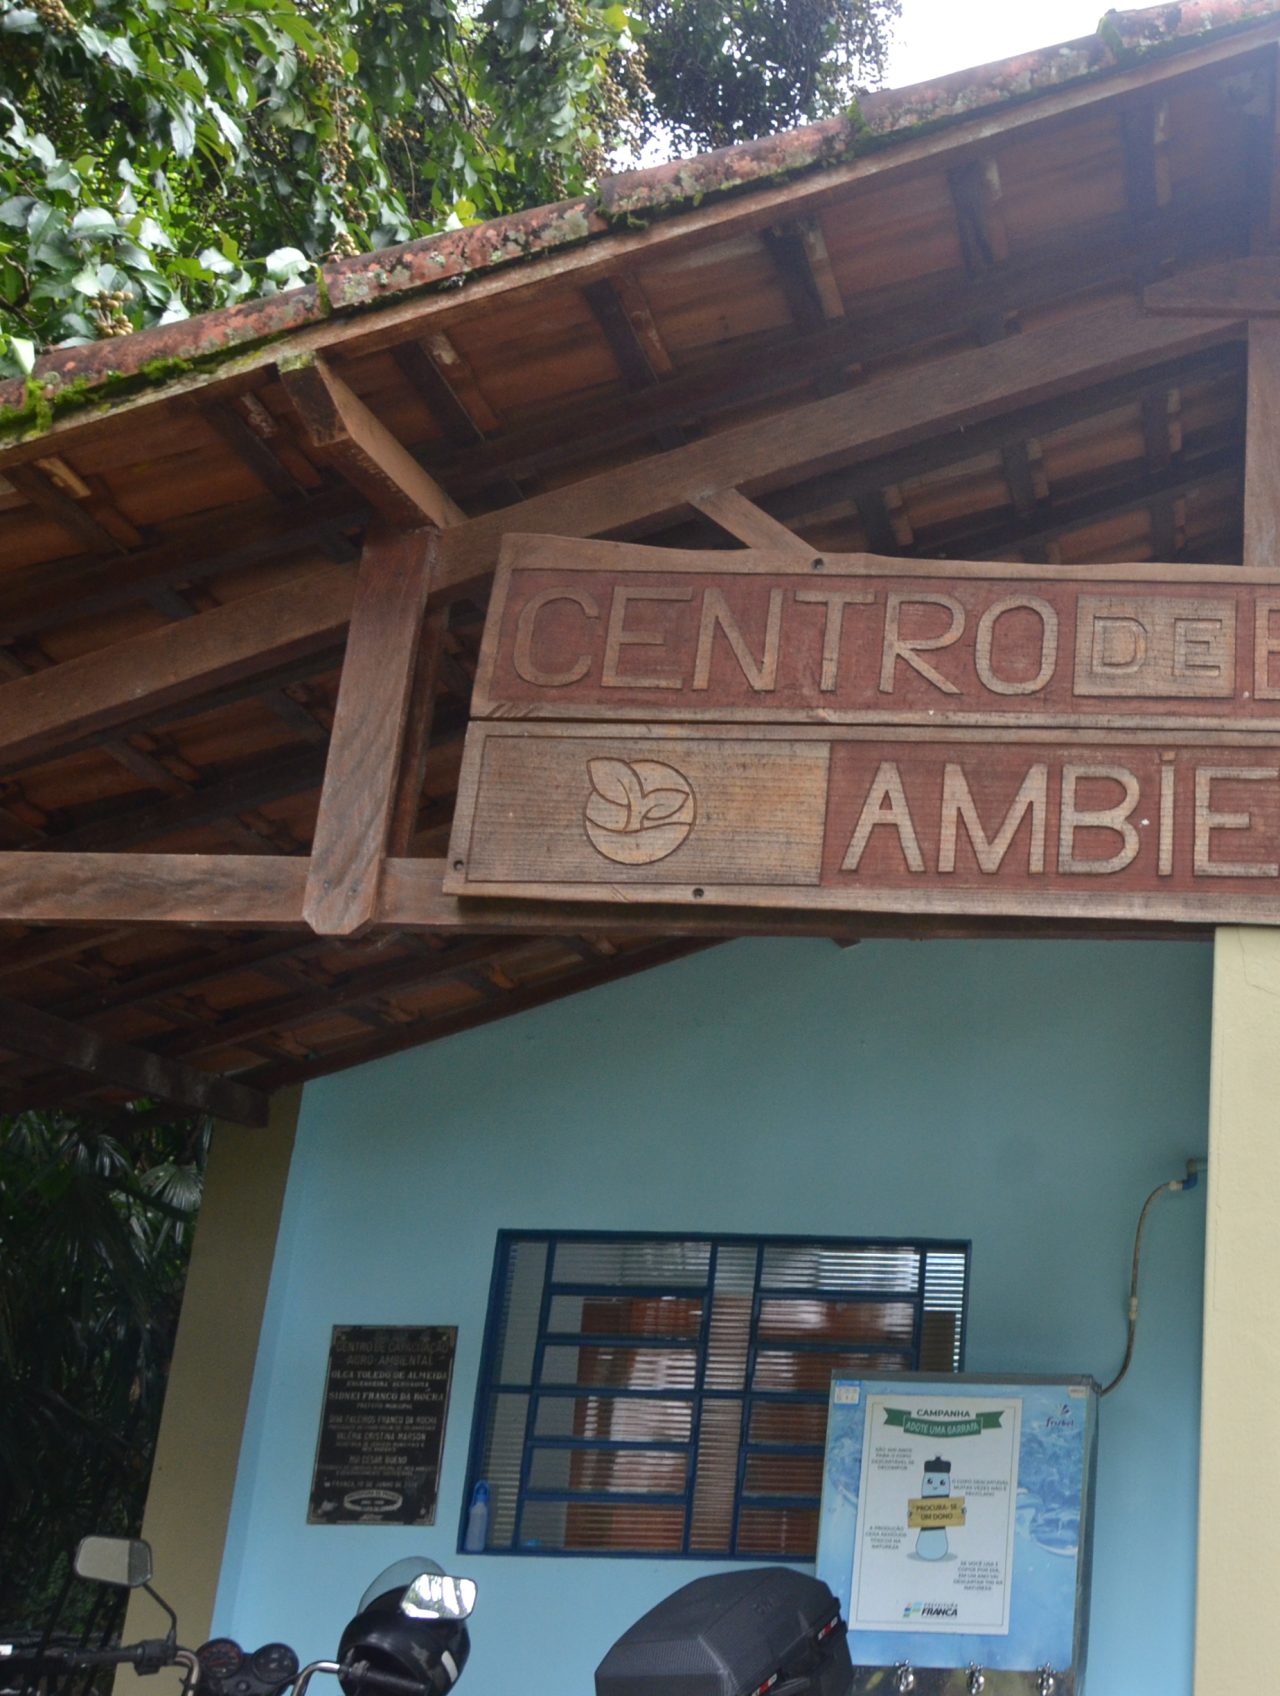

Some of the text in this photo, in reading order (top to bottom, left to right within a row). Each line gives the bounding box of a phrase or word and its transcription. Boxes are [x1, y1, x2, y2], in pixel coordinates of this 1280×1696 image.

[512, 585, 1057, 695] CENTRO
[1093, 614, 1223, 679] DE
[357, 1370, 391, 1379] TOLEDO
[361, 1391, 398, 1401] FRANCO
[399, 1392, 411, 1401] DA
[916, 1409, 971, 1418] CAMPANHA
[905, 1421, 979, 1435] ADOTE UMA GARRAFA
[920, 1513, 953, 1521] UM DONO
[921, 1608, 958, 1616] FRANCA
